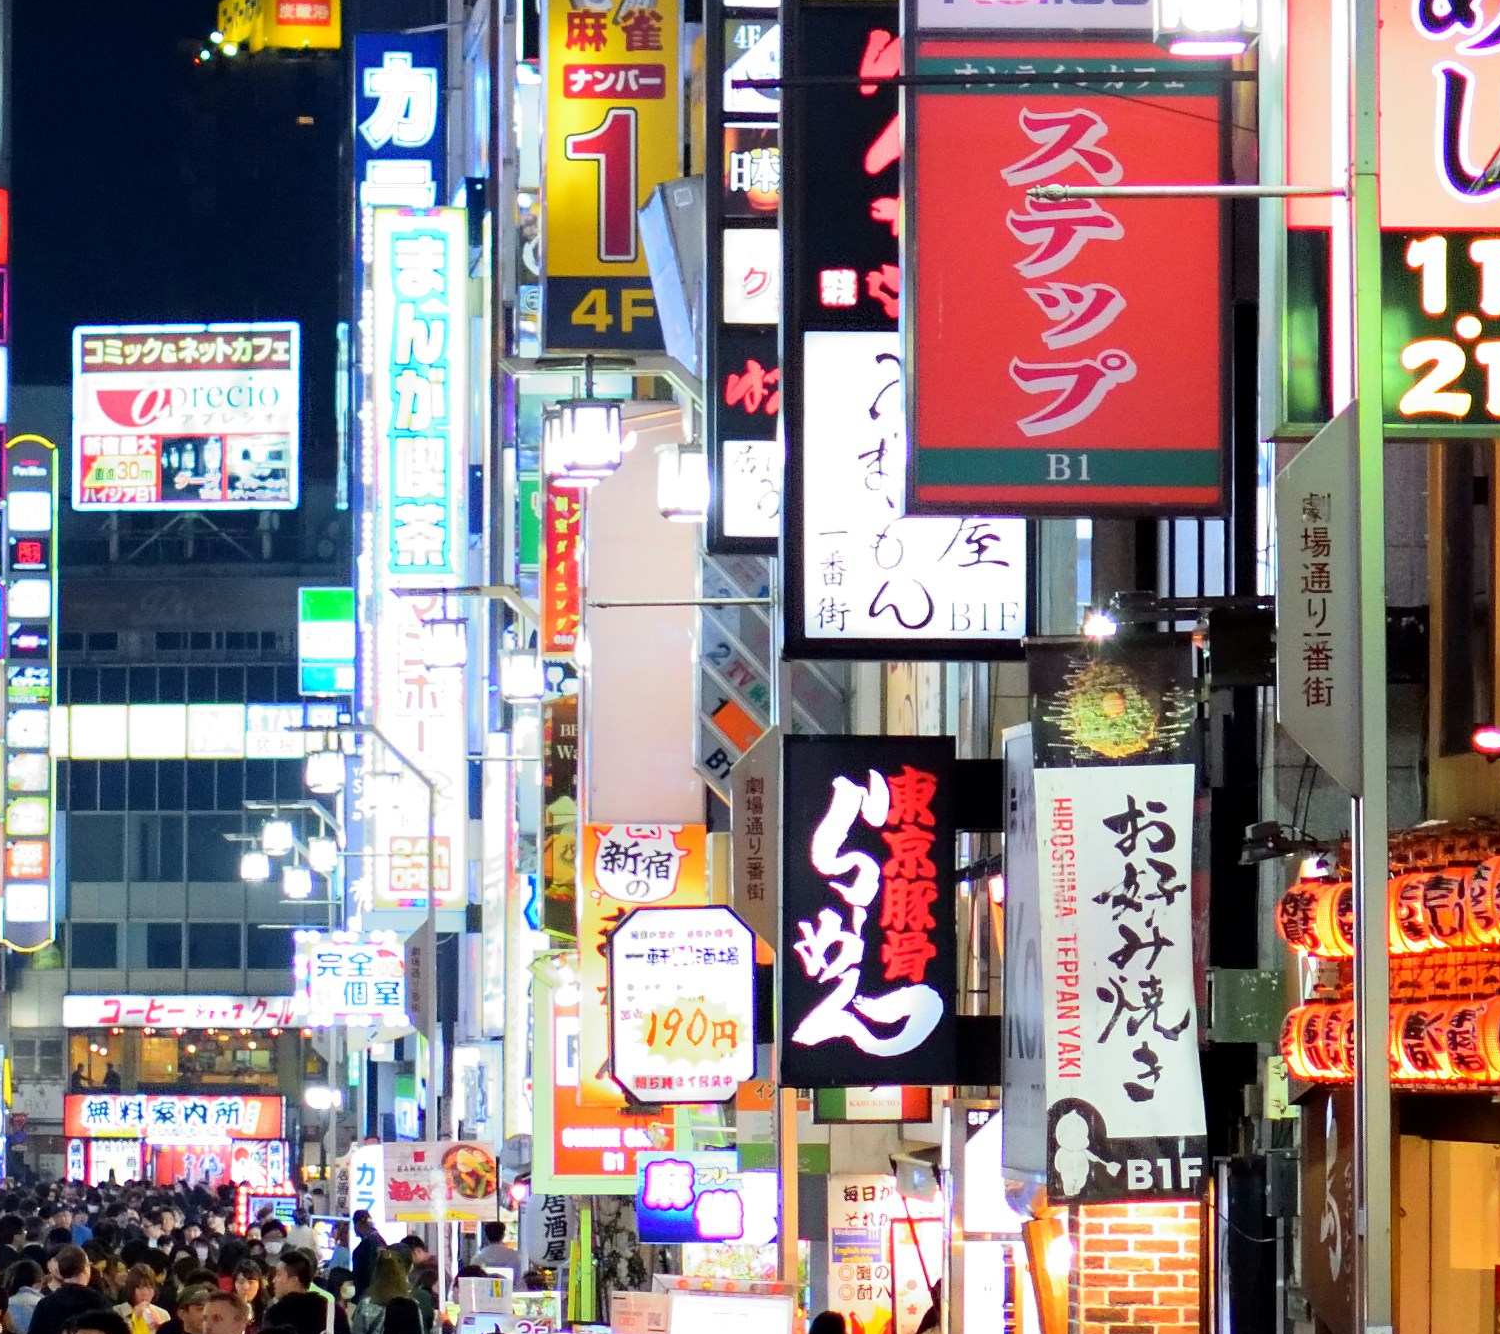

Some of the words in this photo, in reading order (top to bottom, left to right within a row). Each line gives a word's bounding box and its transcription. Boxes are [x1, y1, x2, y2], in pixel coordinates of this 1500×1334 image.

[565, 8, 664, 52] 麻雀
[568, 69, 662, 93] ナンバー
[564, 107, 639, 264] 1
[1000, 106, 1138, 438] ステップ
[570, 288, 656, 334] 4F
[83, 337, 290, 365] コミック&ネットカフェ
[1046, 453, 1091, 481] B1
[814, 529, 852, 633] 一番街
[1300, 492, 1334, 708] 劇場通り一番街
[949, 602, 1020, 633] B1F
[599, 839, 675, 881] 新宿
[745, 775, 765, 902] 劇場通り一番街
[1049, 797, 1079, 920] HIROSHIMA
[625, 878, 651, 898] の
[881, 765, 940, 984] 東京豚骨
[317, 953, 373, 977] 完全
[1092, 794, 1193, 1104] お好み焼き
[98, 999, 184, 1025] コーヒー
[252, 998, 295, 1026] クール
[344, 980, 401, 1007] 個室
[646, 1008, 738, 1049] 190円
[1055, 1024, 1083, 1081] YAKI
[86, 1099, 243, 1127] 無料案内所
[1126, 1156, 1204, 1192] B1F
[540, 1194, 567, 1263] 居酒屋
